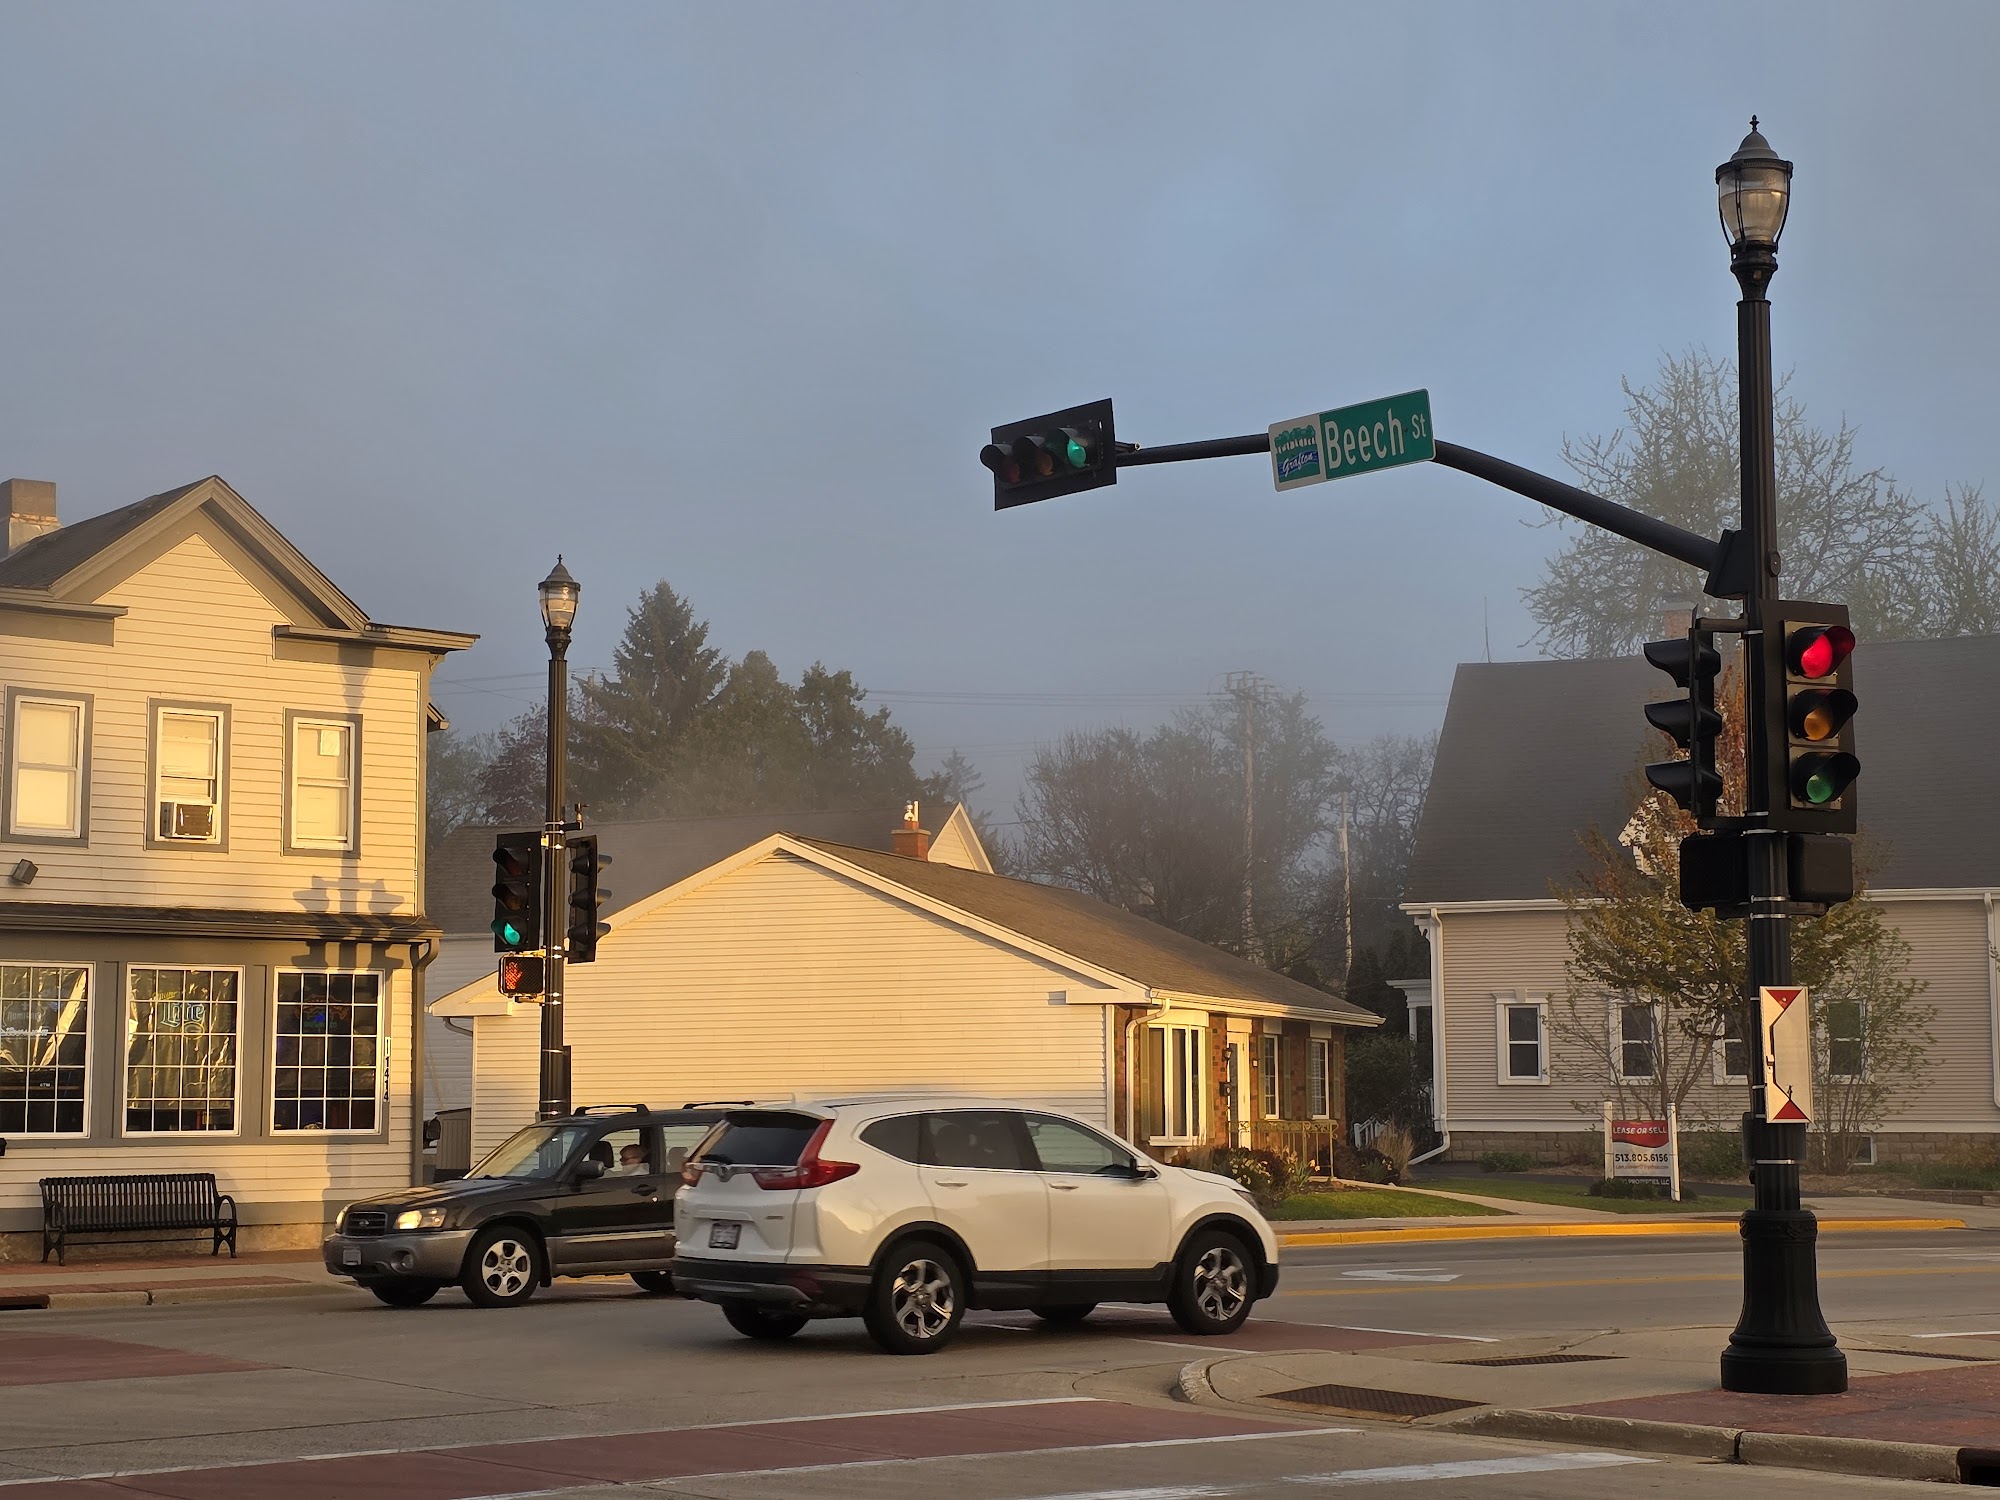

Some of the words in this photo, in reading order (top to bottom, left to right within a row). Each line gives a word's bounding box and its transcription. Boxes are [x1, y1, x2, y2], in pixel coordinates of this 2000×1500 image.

[1324, 408, 1405, 469] Beech
[1411, 413, 1427, 439] St
[1282, 452, 1314, 477] Grafton
[1615, 1153, 1669, 1162] 513.805.6156
